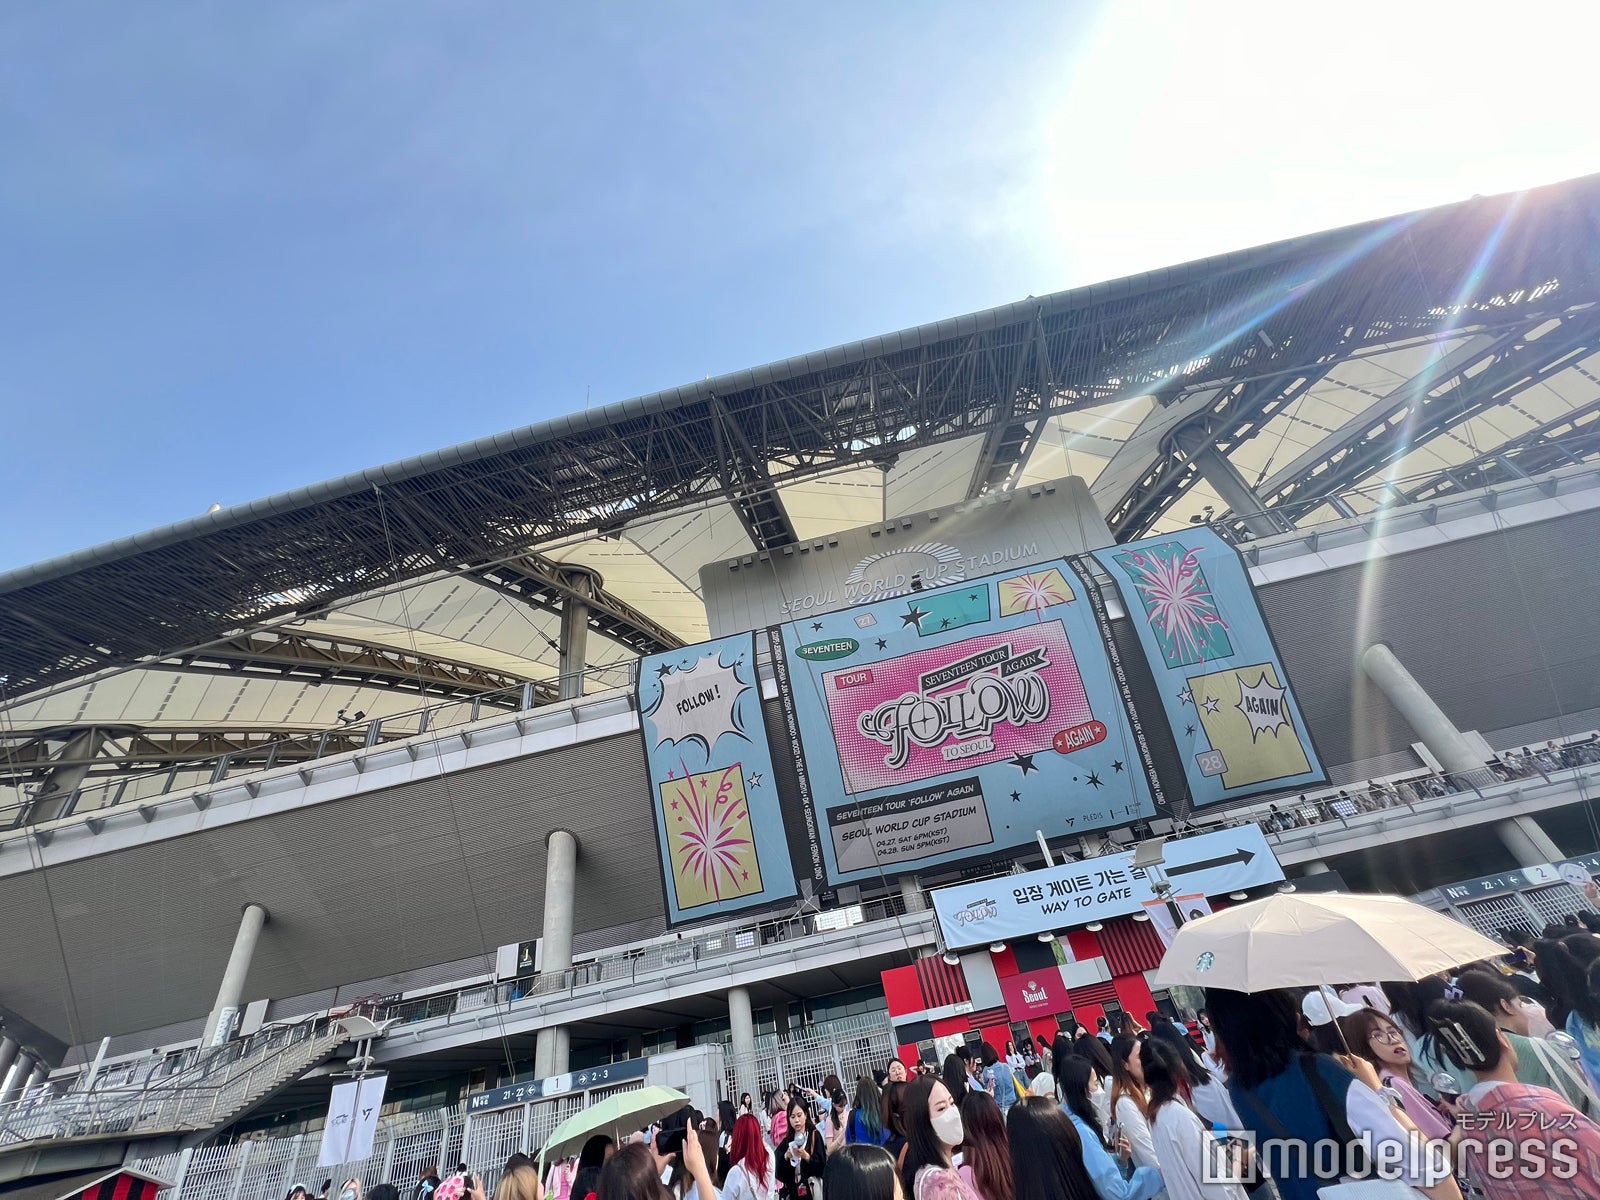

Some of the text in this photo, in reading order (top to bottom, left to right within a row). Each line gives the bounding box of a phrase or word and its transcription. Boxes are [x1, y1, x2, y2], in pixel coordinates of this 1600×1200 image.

[781, 591, 837, 614] SEOUL
[844, 574, 906, 599] WORLD
[955, 542, 1038, 573] STADIUM
[859, 616, 871, 626] 27
[801, 641, 853, 655] SEVENTEEN
[924, 650, 1006, 687] SEVENTEEN TOUR
[1005, 655, 1037, 674] AGAIN
[840, 673, 868, 685] TOUR
[1245, 696, 1279, 717] AGAIN
[860, 674, 1049, 768] FOLLOW
[1064, 725, 1095, 749] AGAIN
[944, 740, 992, 759] TO SEOUL
[1127, 701, 1139, 721] MINGYU
[1137, 734, 1153, 766] SEUNGKWAN
[1148, 767, 1160, 790] VERNON
[1155, 791, 1166, 805] DINO
[1201, 755, 1222, 772] 28
[799, 775, 808, 795] MINGYU
[836, 804, 883, 821] SEVENTEEN
[885, 801, 906, 811] TOUR
[947, 784, 974, 798] AGAIN
[804, 808, 817, 841] SEUNGKWAN
[842, 806, 977, 841] SEOUL WORLD CUP STADIUM
[1082, 812, 1104, 822] PLEDIS
[898, 835, 912, 844] SAT
[913, 827, 948, 841] 6PM(KST)
[901, 844, 915, 852] SUN
[916, 835, 950, 850] 5PM(KST)
[810, 843, 820, 865] VERNON
[814, 867, 823, 880] DINO
[1535, 867, 1548, 879] 2
[1012, 885, 1044, 905] 입장
[1046, 875, 1094, 898] 게이트
[1094, 869, 1127, 887] 가는
[1041, 887, 1132, 915] WAY TO GATE
[472, 1096, 480, 1108] N
